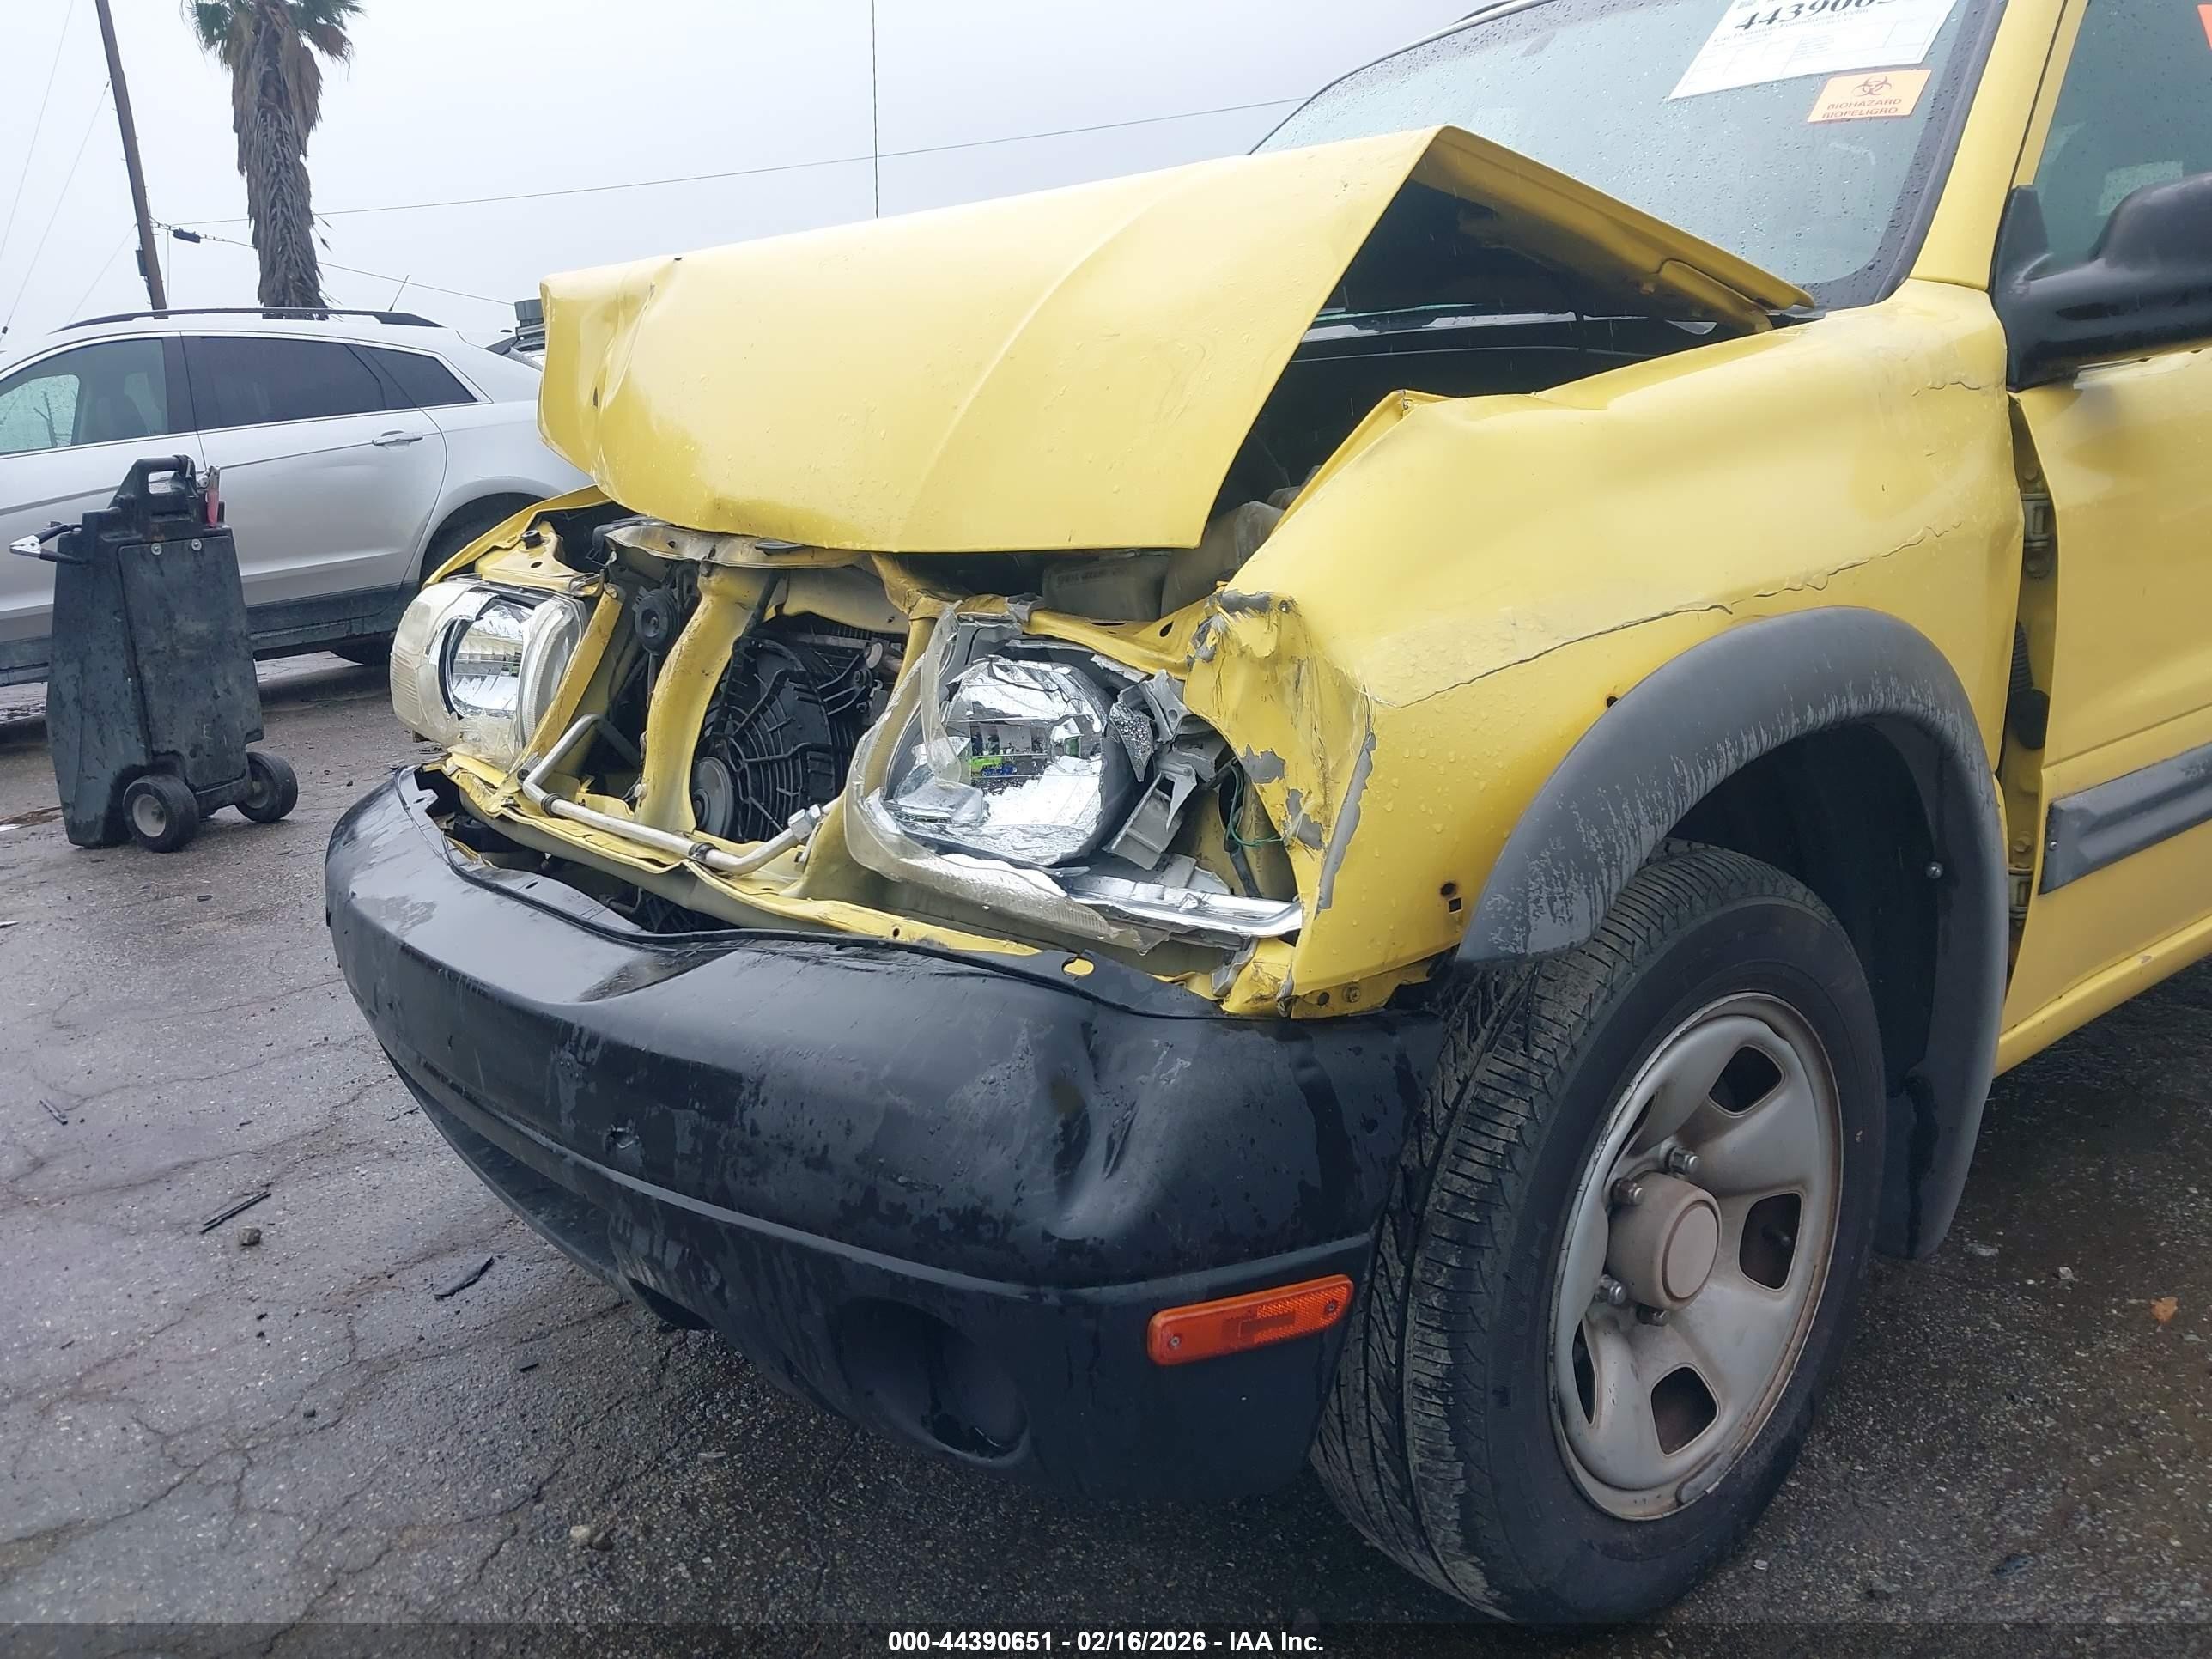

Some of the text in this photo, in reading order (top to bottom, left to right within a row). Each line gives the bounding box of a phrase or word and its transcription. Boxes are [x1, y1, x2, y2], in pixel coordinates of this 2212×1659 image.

[1735, 0, 1896, 30] 44390
[1826, 98, 1902, 110] BIOHAZARD
[1821, 107, 1899, 118] BIOPELIGRO
